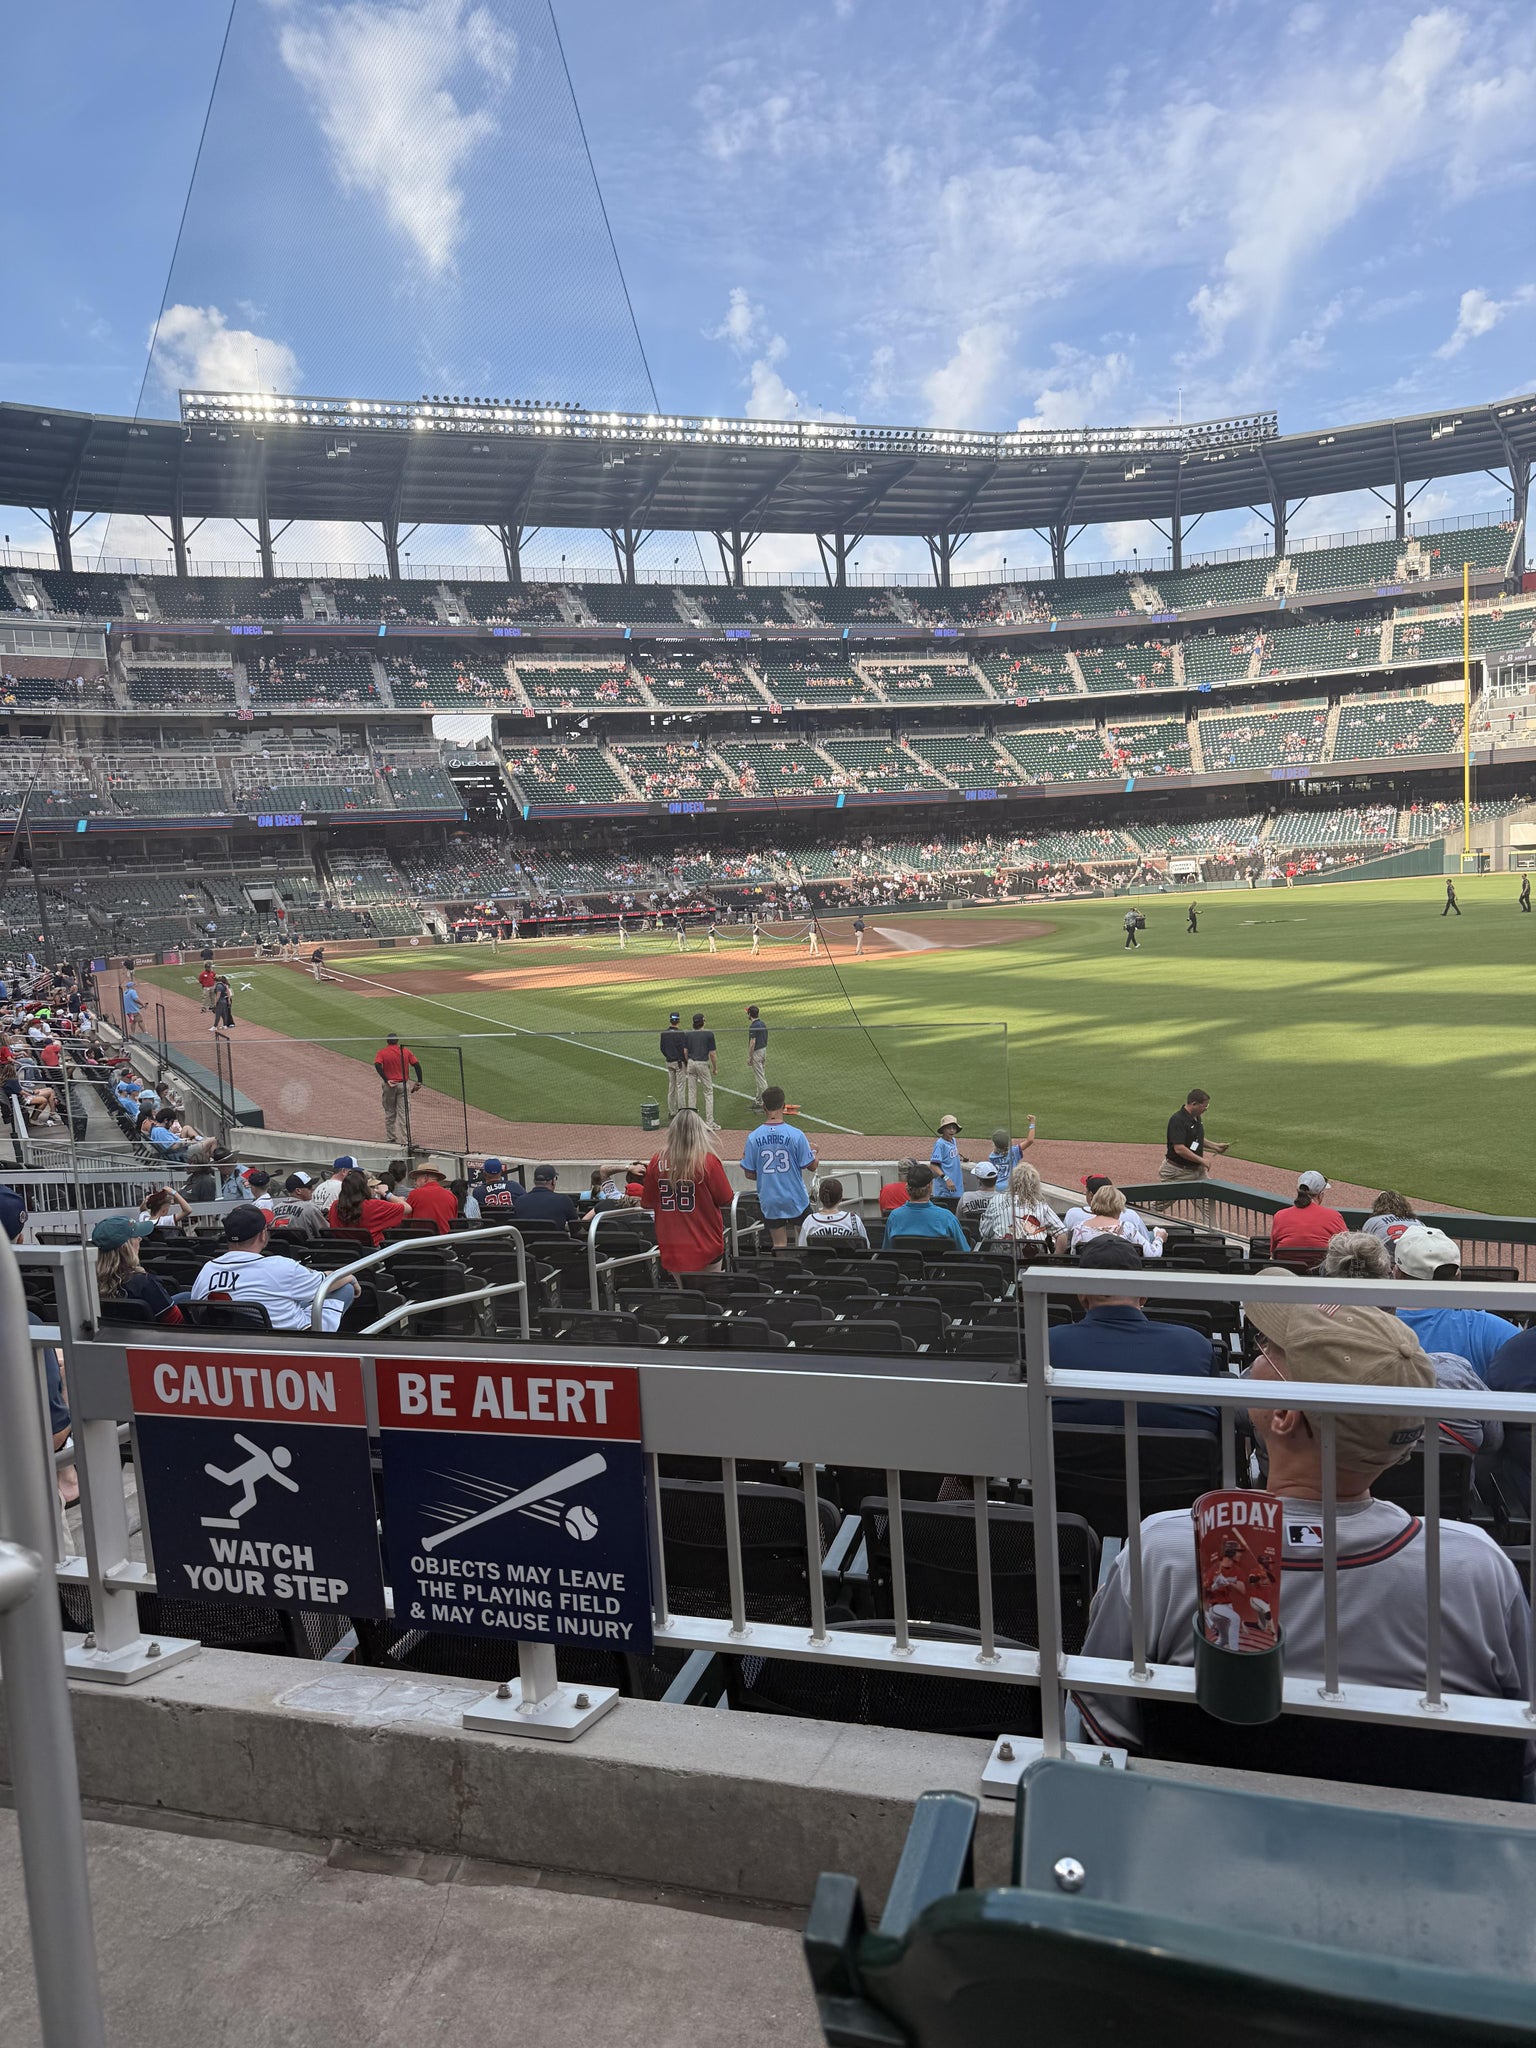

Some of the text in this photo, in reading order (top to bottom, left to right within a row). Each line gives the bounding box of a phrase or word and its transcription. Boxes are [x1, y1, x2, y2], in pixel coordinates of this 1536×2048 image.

[231, 626, 242, 635] ON
[243, 626, 263, 635] DECK
[238, 709, 254, 720] 35
[1286, 767, 1311, 779] DECK
[965, 790, 977, 800] ON
[978, 789, 998, 800] DECK
[669, 803, 682, 814] ON
[683, 802, 705, 813] DECK
[258, 815, 273, 827] ON
[275, 814, 303, 827] DECK
[756, 1133, 784, 1147] HARRIS
[761, 1149, 791, 1174] 23
[486, 1183, 507, 1193] OLSON
[658, 1179, 695, 1212] 28
[272, 1205, 304, 1218] REEMAN
[209, 1271, 240, 1291] COX
[153, 1363, 337, 1412] CAUTION
[398, 1373, 614, 1424] BE ALERT
[209, 1537, 314, 1571] WATCH
[182, 1563, 349, 1604] YOUR STEP
[410, 1555, 625, 1592] OBJECTS MAY LEAVE
[417, 1579, 620, 1616] THE PLAYING FIELD
[410, 1602, 634, 1641] & MAY CAUSE INJURY
